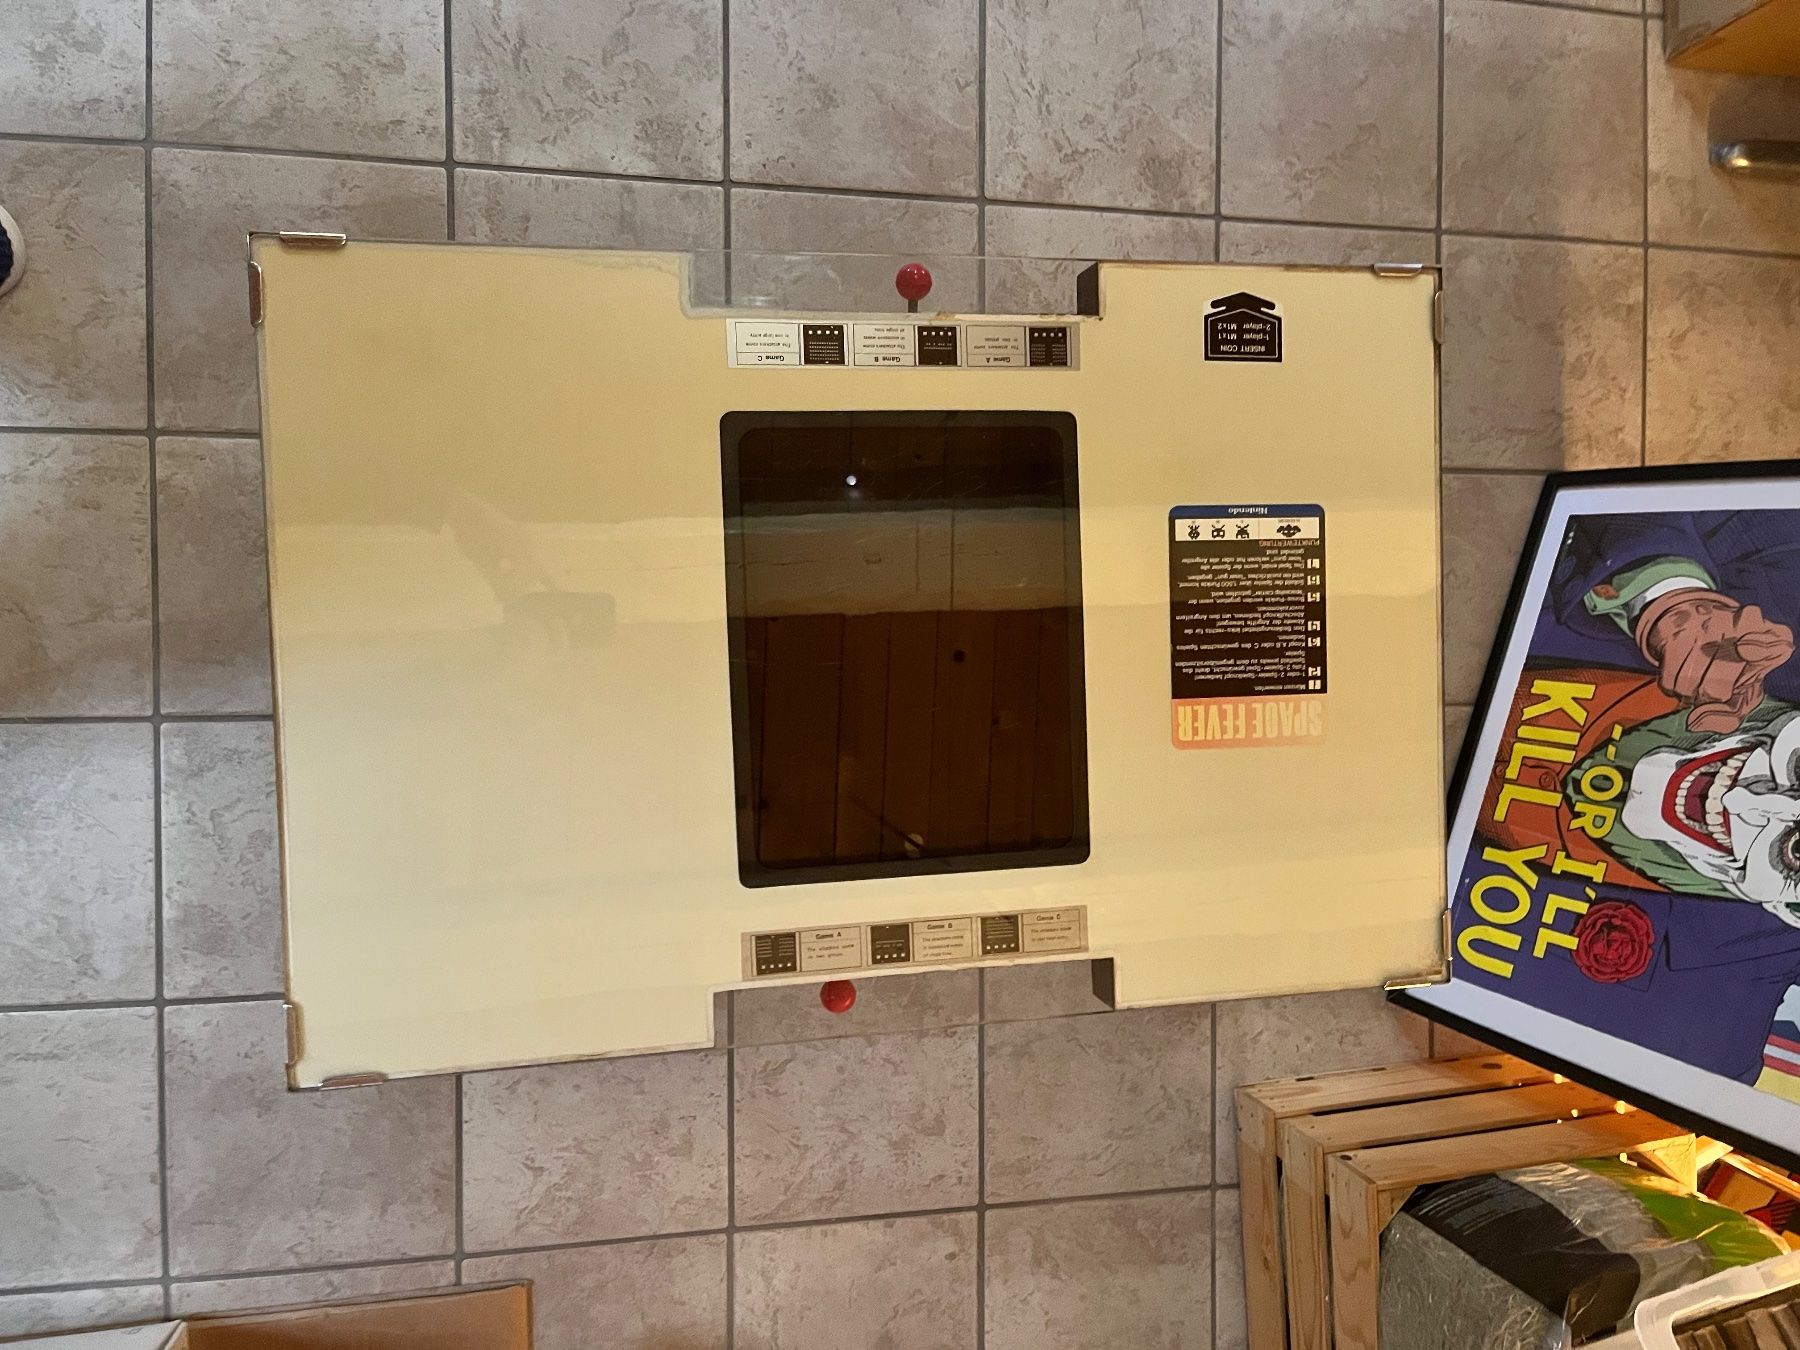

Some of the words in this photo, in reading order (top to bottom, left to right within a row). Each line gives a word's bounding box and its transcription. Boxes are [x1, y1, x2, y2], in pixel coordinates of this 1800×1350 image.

[1243, 322, 1270, 331] 2-player
[1243, 333, 1269, 341] 1-player
[1228, 506, 1268, 514] Nintendo
[1177, 703, 1246, 741] FEVER
[1493, 678, 1597, 823] KILL
[1456, 844, 1549, 980] YOU
[1533, 849, 1608, 959] I'LL
